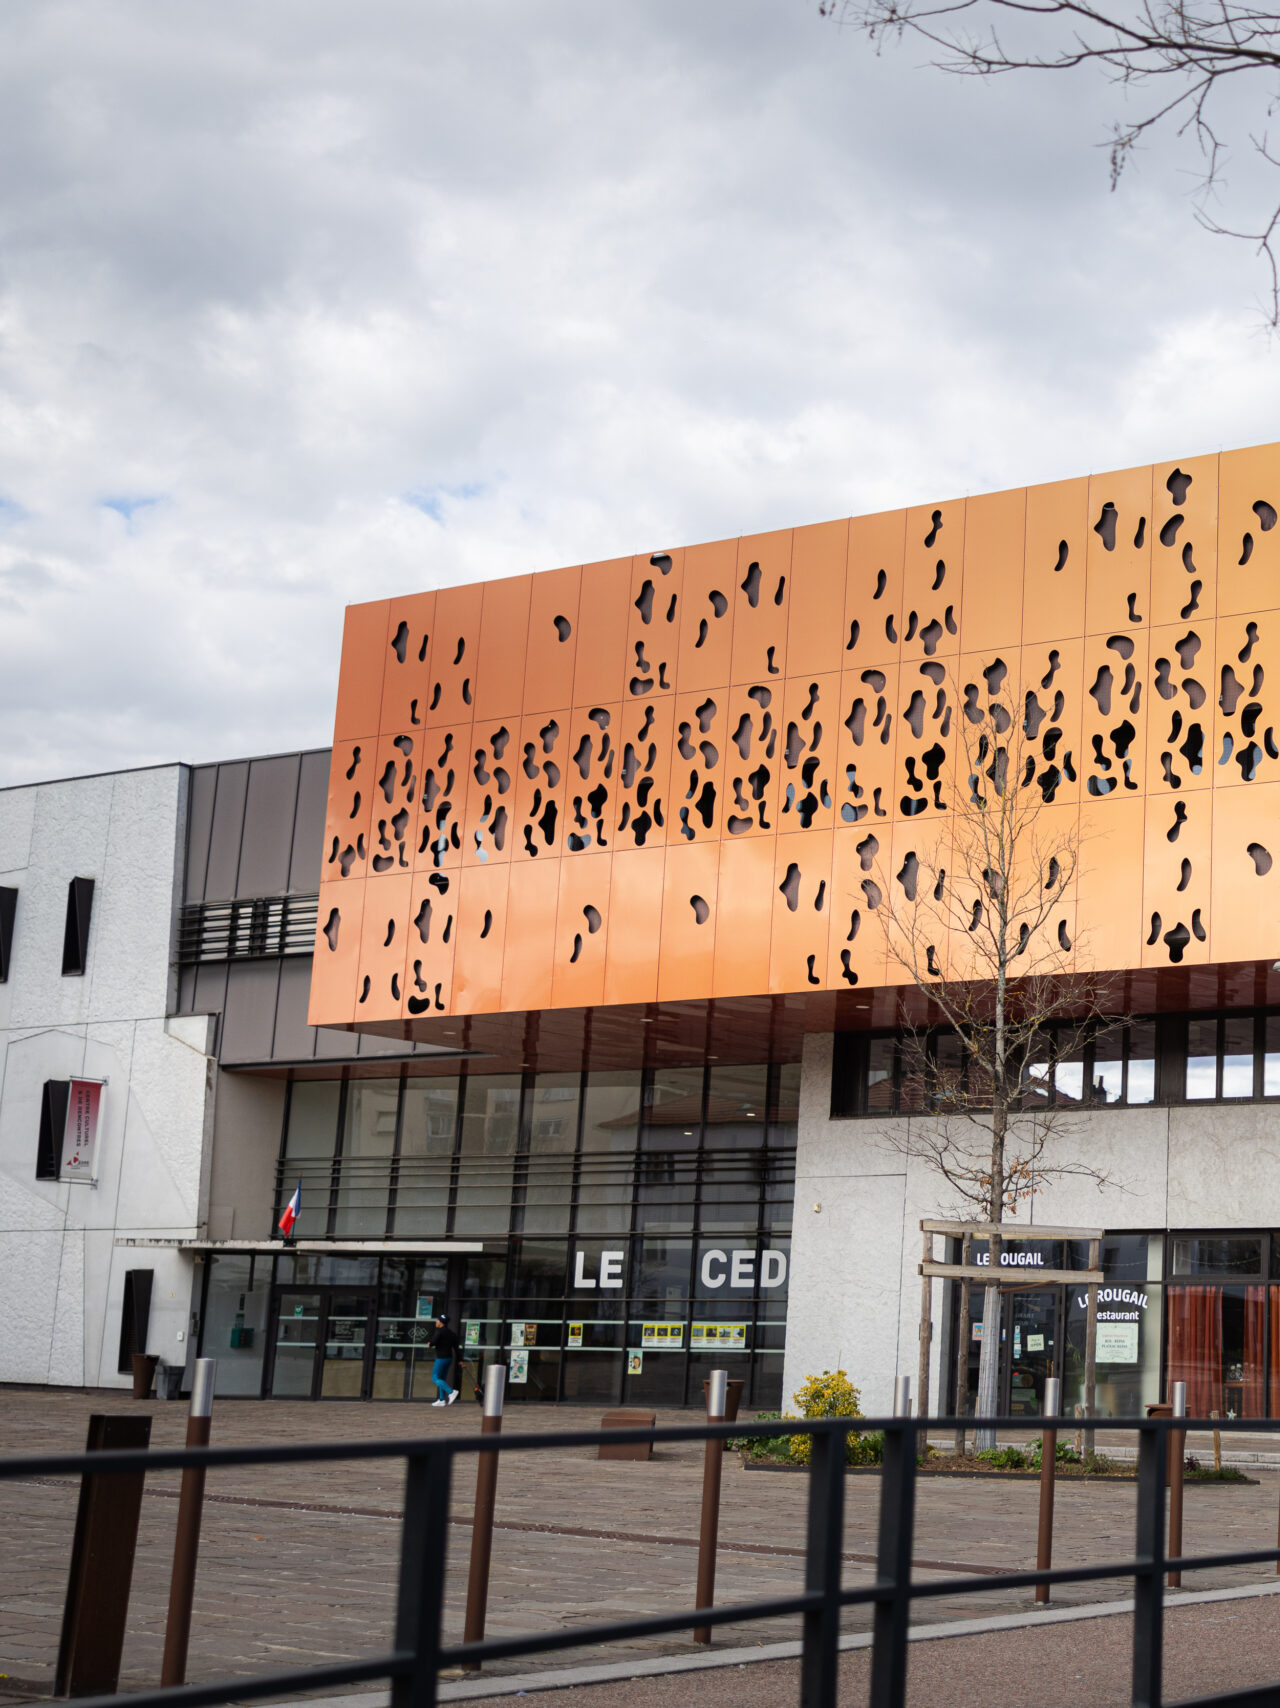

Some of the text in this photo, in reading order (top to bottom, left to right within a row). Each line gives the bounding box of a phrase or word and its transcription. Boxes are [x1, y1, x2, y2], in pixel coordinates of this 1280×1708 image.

[976, 1252, 1044, 1266] LE OUGAIL
[575, 1249, 787, 1289] LE CED
[1097, 1288, 1148, 1309] ROUGAIL
[1096, 1310, 1140, 1320] estaurant
